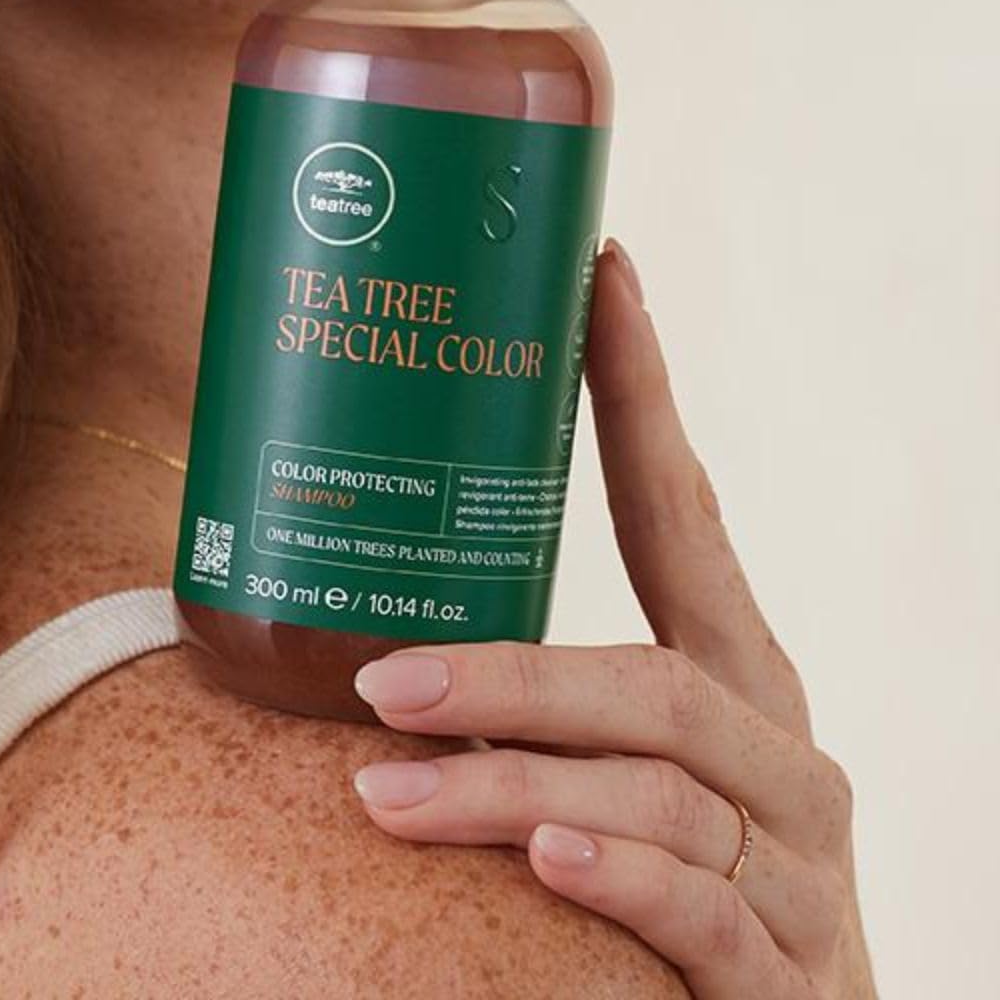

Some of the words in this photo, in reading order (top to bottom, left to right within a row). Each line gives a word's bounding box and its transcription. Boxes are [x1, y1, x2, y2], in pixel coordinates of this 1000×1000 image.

[310, 193, 373, 217] teatree
[283, 266, 349, 313] TEA
[358, 277, 456, 325] TREE
[276, 313, 427, 369] SPECIAL
[437, 334, 544, 378] COLOR
[271, 459, 327, 483] COLOR
[329, 469, 436, 497] PROTECTING
[271, 481, 355, 510] SHAMPOO
[266, 526, 294, 545] ONE
[295, 531, 351, 553] MILLION
[354, 540, 396, 560] TREES
[399, 545, 456, 564] PLANTED
[457, 551, 483, 565] AND
[483, 552, 531, 567] COUNTING
[244, 573, 289, 601] 300
[292, 586, 319, 606] ml
[369, 593, 417, 617] 10.14
